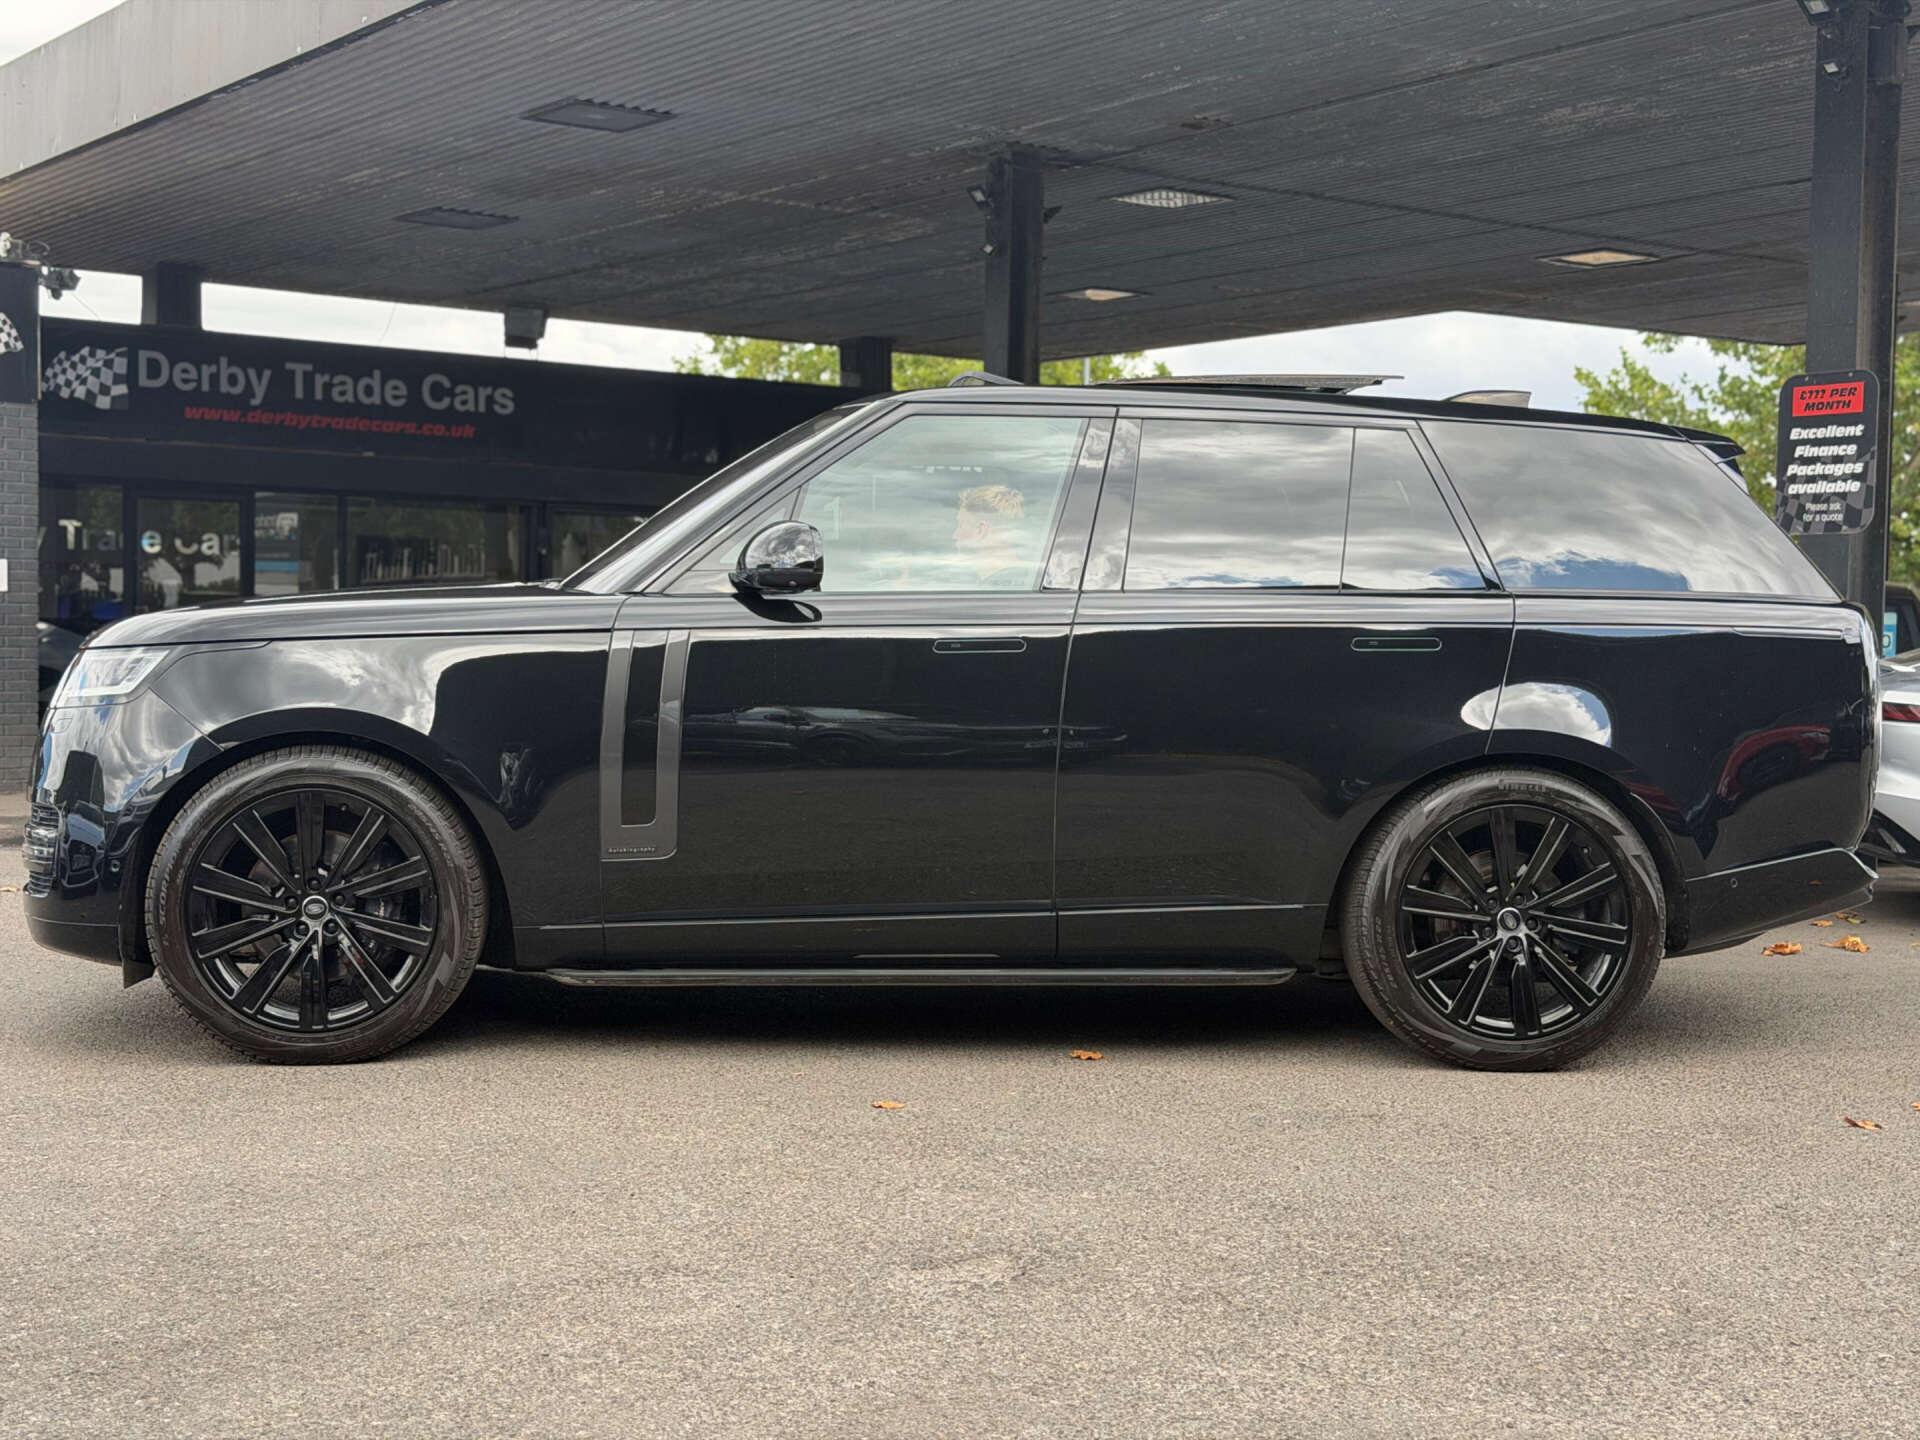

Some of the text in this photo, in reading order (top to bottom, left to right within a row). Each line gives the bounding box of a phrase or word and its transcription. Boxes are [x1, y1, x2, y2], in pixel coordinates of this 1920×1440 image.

[137, 349, 515, 415] Derby Trade Cars
[1830, 387, 1857, 398] PER
[1804, 400, 1851, 411] MONTH
[183, 405, 477, 439] www.derbytradecars.co.uk
[1789, 423, 1865, 440] Excellent
[1794, 444, 1858, 459] Finance
[1786, 462, 1865, 477] Packages
[1787, 480, 1861, 495] available
